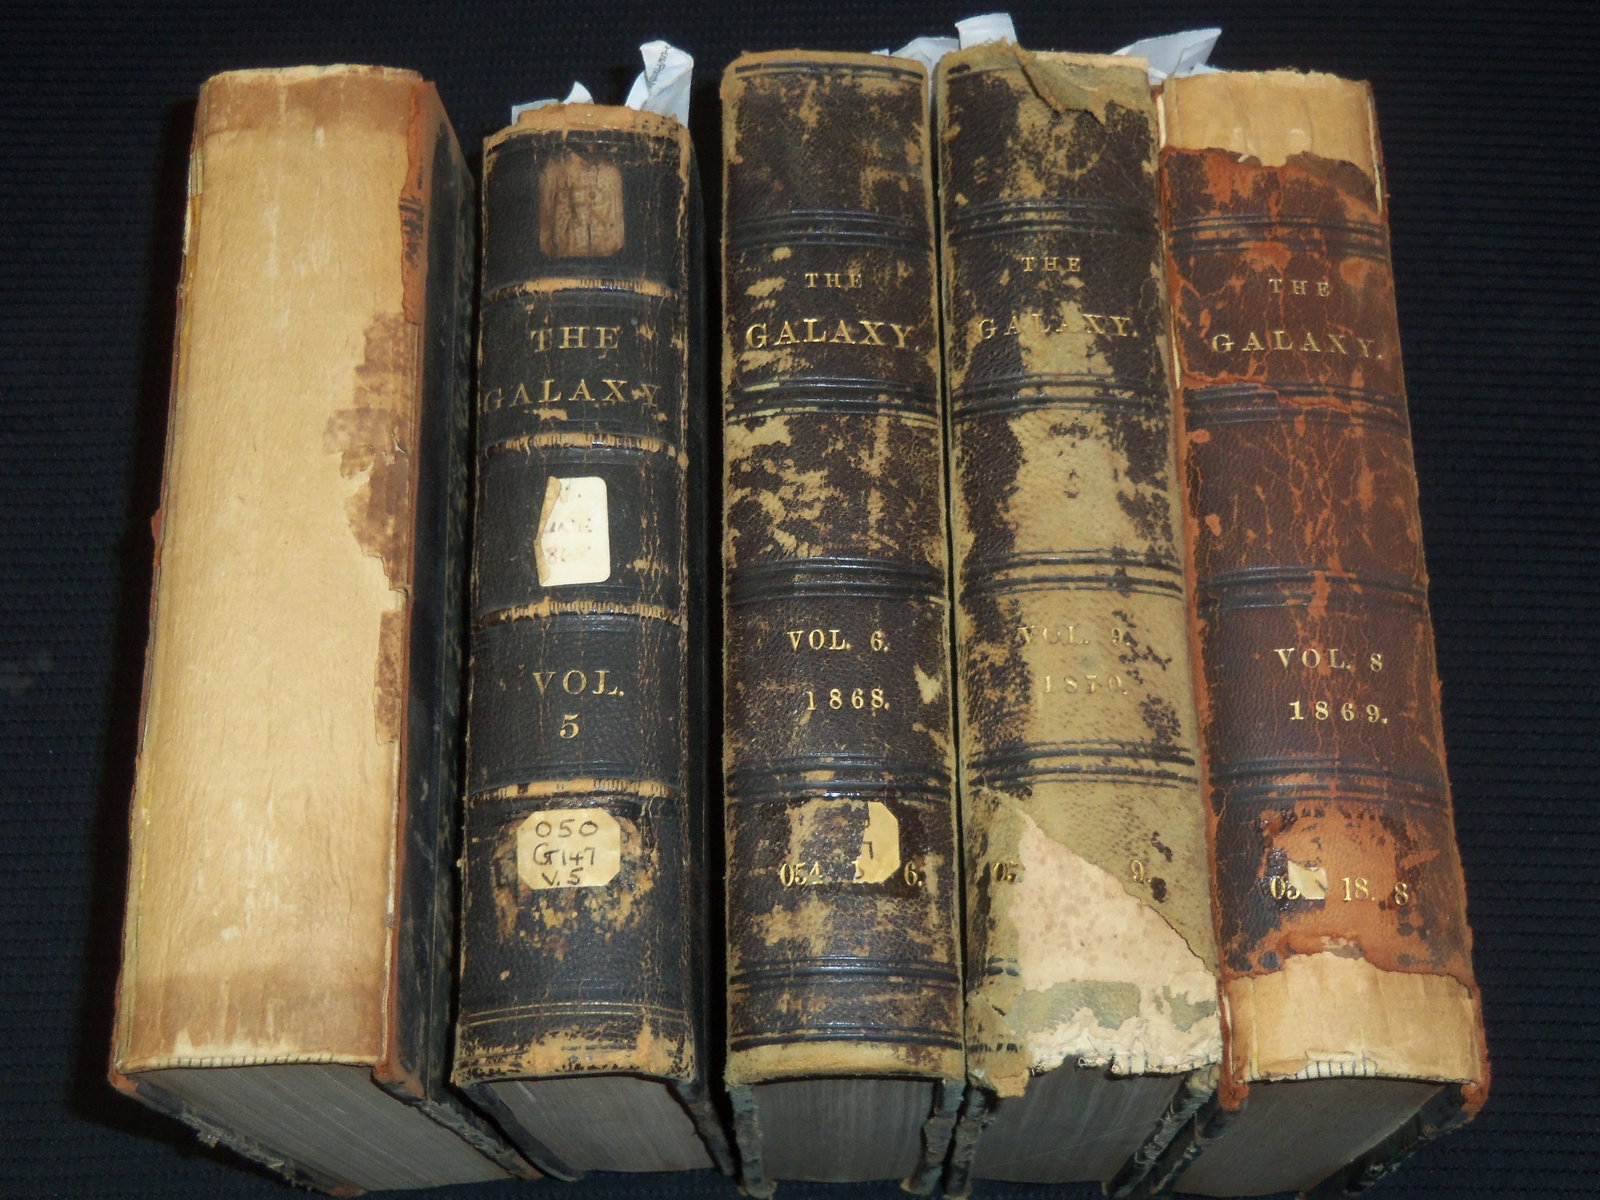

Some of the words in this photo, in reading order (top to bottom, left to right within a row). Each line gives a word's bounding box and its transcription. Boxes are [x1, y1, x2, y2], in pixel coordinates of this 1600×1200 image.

[1022, 257, 1081, 272] THE
[805, 272, 863, 289] THE
[1268, 278, 1331, 297] THE
[530, 326, 620, 353] THE
[787, 628, 851, 651] VOL.
[870, 630, 889, 653] 6.
[1274, 647, 1351, 669] VOL.
[1370, 653, 1382, 672] 8
[532, 669, 625, 697] VOL.
[806, 687, 891, 710] 1868.
[1289, 700, 1388, 725] 1869.
[559, 714, 580, 739] 5
[534, 819, 599, 838] 050
[904, 861, 923, 887] 6.
